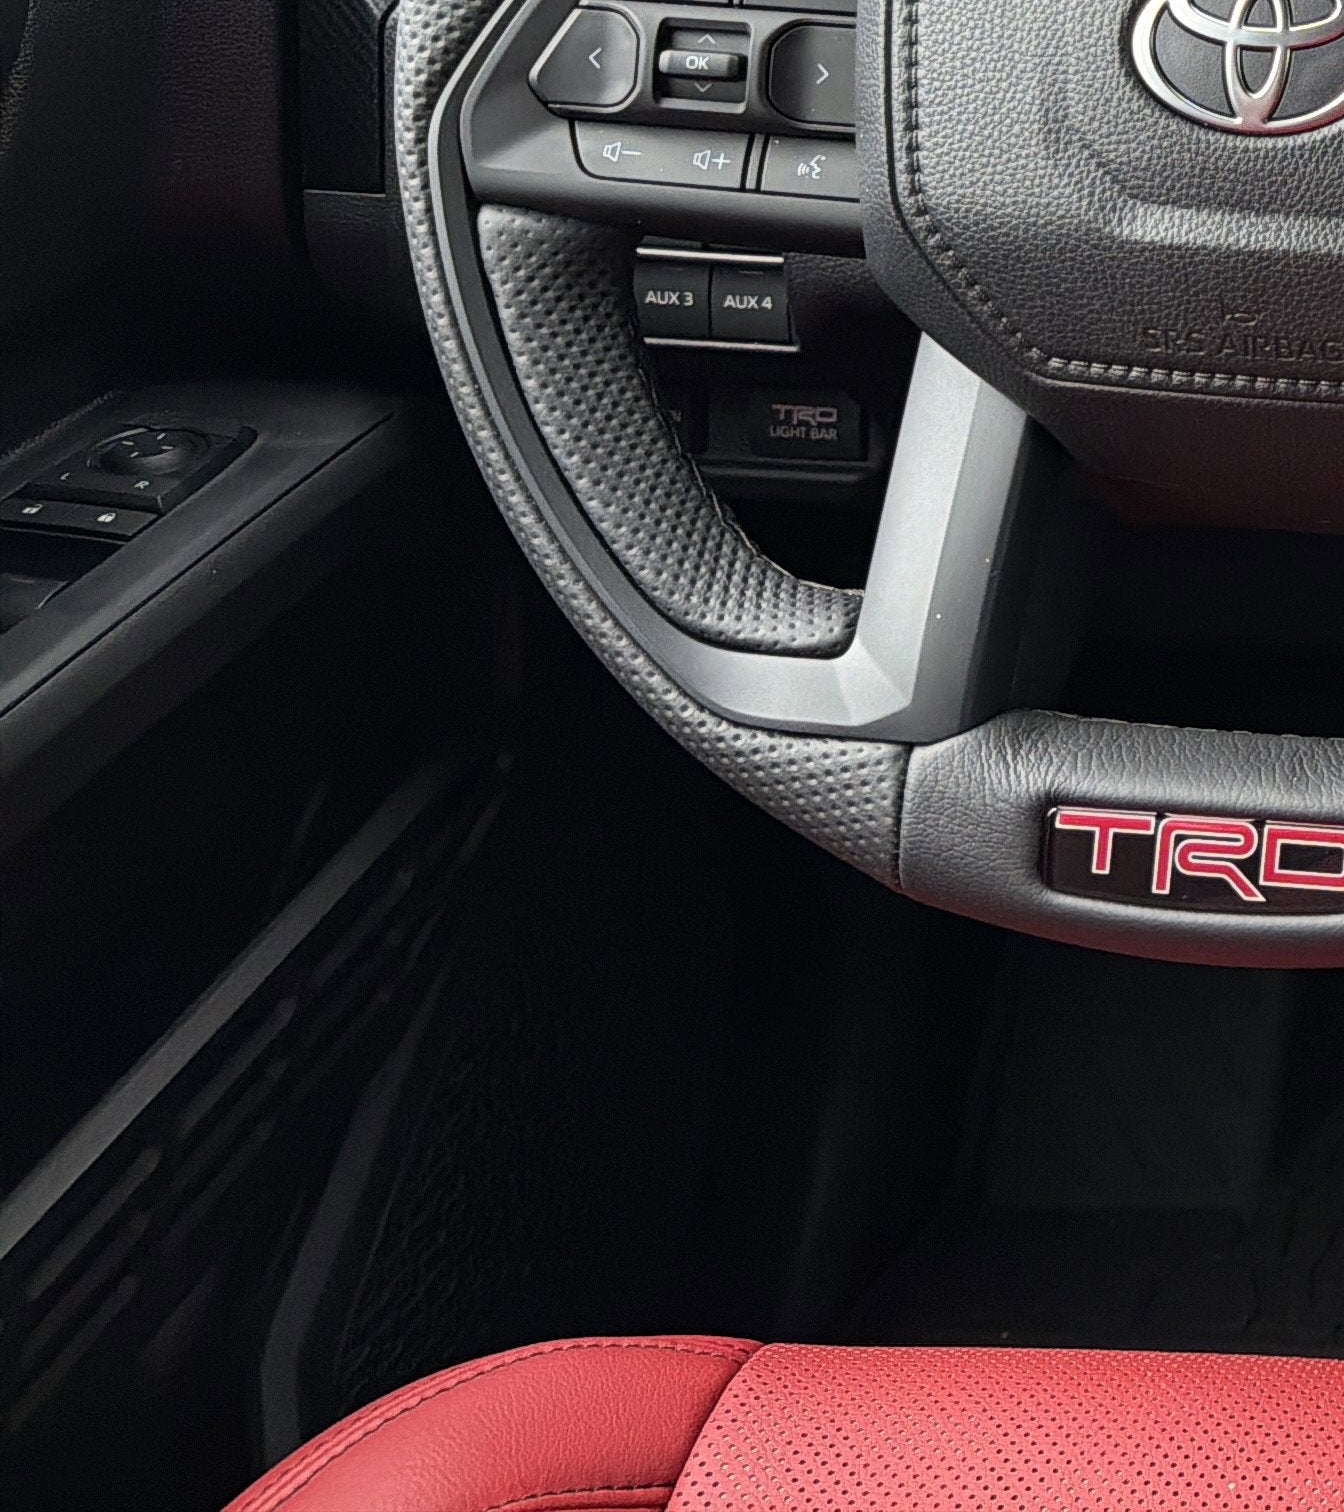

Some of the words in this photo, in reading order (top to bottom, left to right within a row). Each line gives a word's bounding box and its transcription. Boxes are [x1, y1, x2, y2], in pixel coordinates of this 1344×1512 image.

[685, 55, 710, 70] OK
[645, 290, 681, 306] AUX
[683, 291, 694, 306] 3
[723, 294, 759, 310] AUX
[761, 295, 773, 310] 4
[772, 403, 838, 425] TRD
[769, 424, 807, 439] LIGHT
[809, 426, 839, 440] BAR
